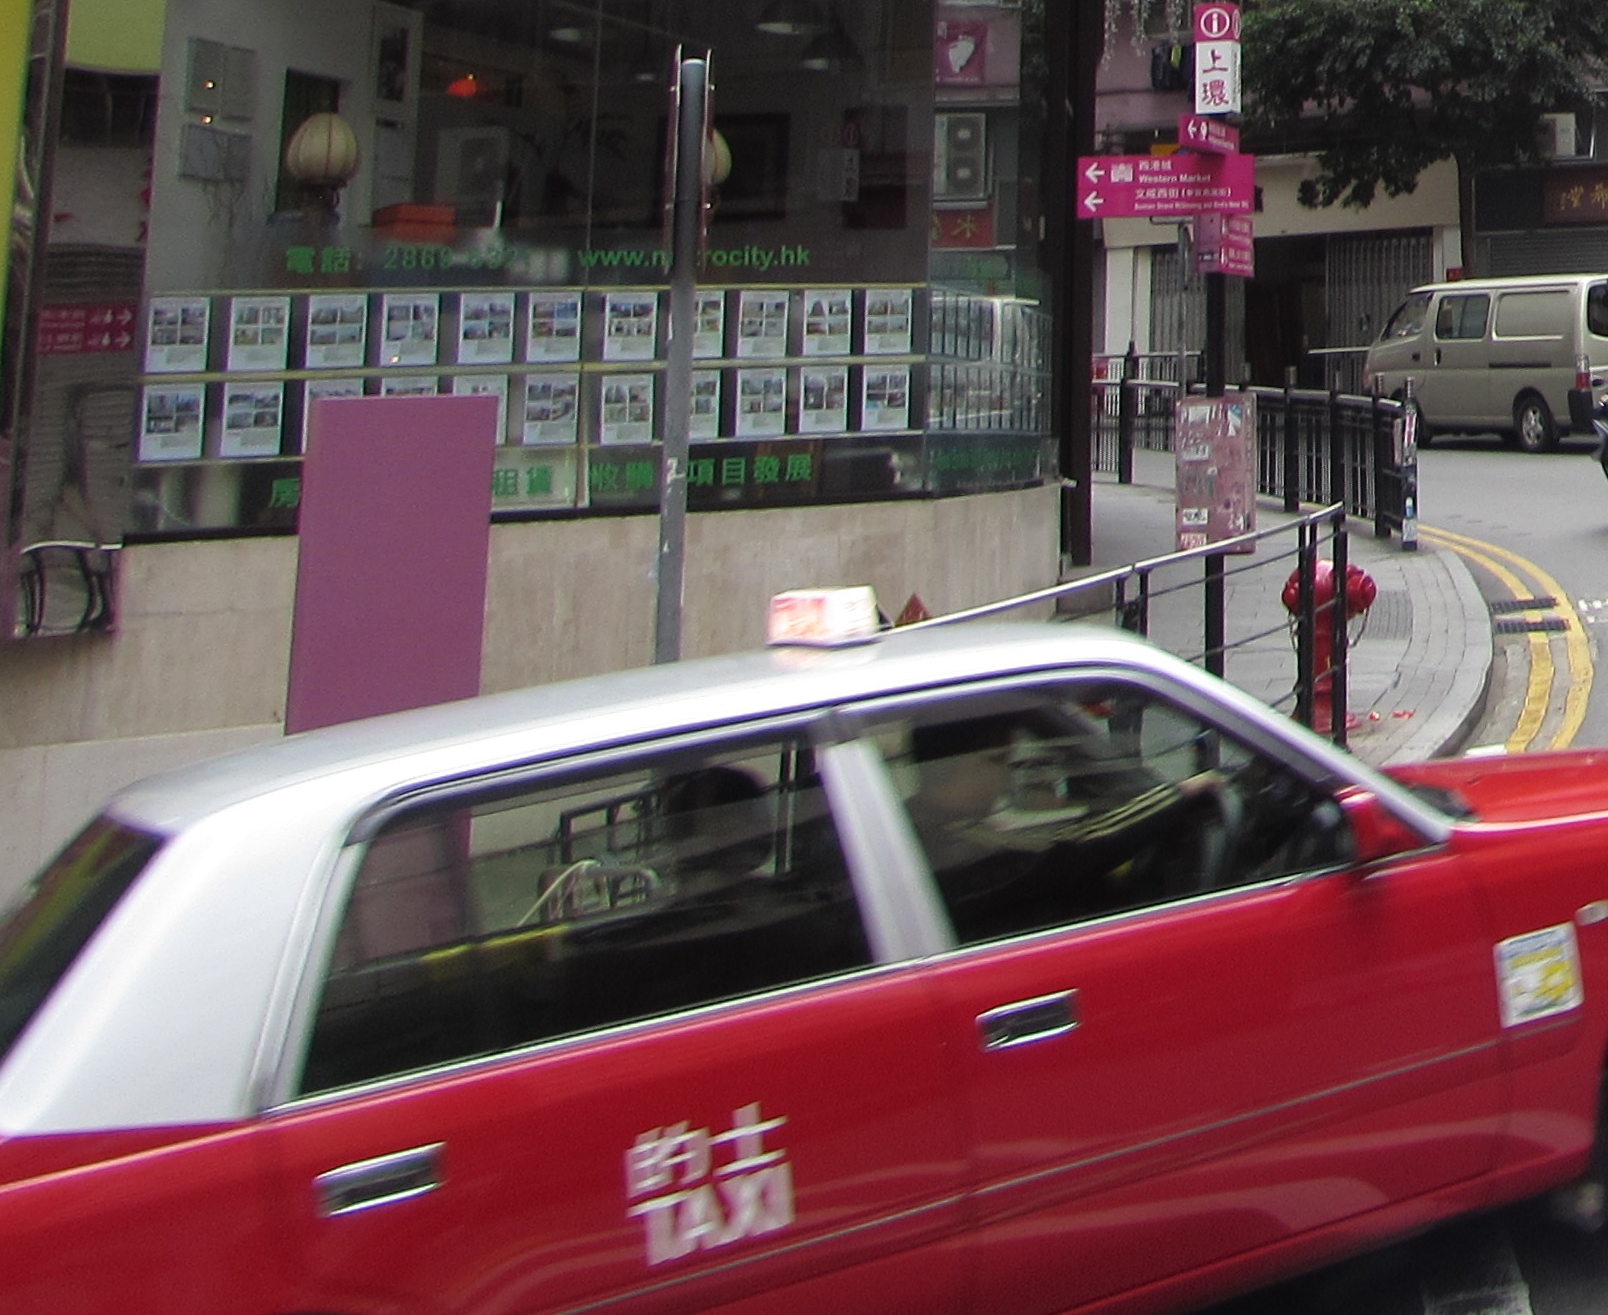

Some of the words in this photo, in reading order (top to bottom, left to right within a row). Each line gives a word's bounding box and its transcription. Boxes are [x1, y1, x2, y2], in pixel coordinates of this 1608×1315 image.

[1202, 49, 1230, 106] 上環
[1138, 174, 1177, 184] Western
[1179, 173, 1211, 183] Market
[578, 244, 811, 271] www.mrocity.hk
[686, 453, 813, 486] 項目發展
[624, 1101, 788, 1199] 的士
[626, 1161, 795, 1267] TAXI
